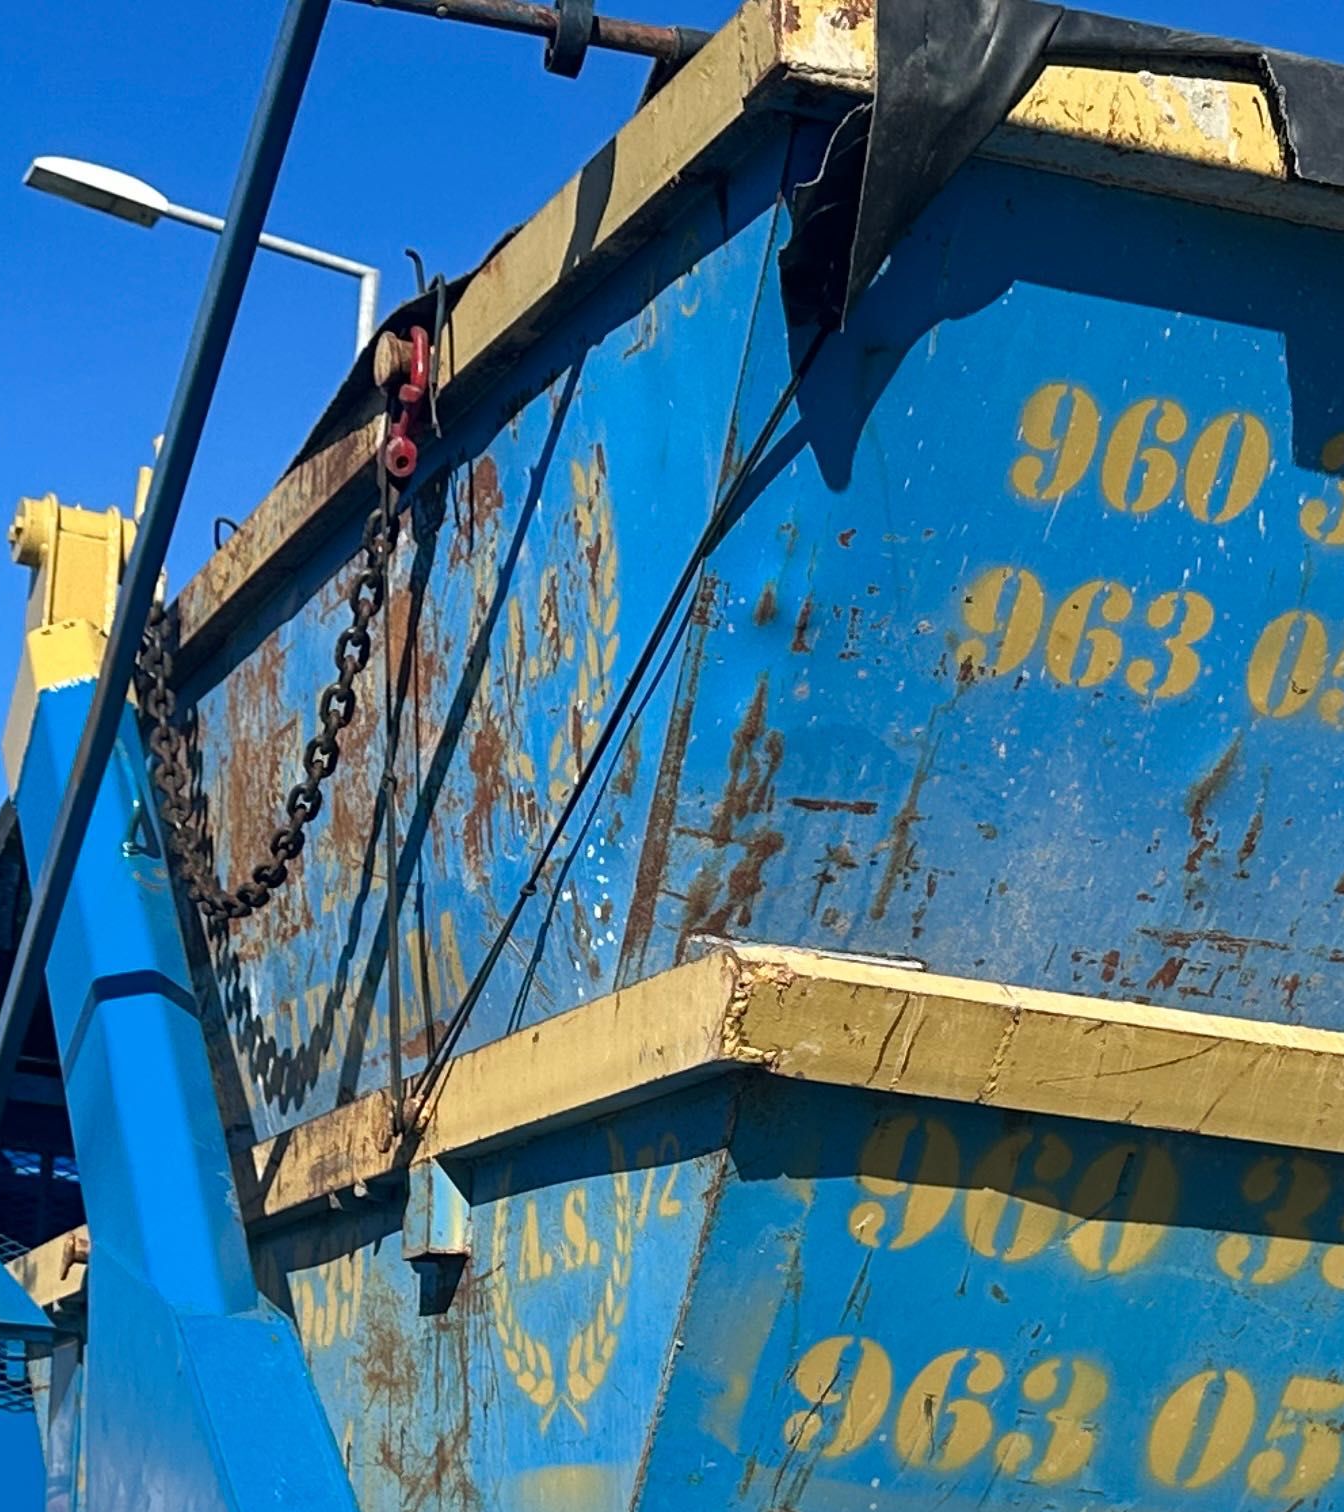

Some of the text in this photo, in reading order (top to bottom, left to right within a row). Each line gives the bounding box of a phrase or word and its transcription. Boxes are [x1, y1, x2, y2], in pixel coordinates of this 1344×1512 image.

[1009, 381, 1273, 525] 960
[955, 567, 1215, 701] 963
[850, 1113, 1179, 1277] 960
[785, 1334, 1110, 1486] 963
